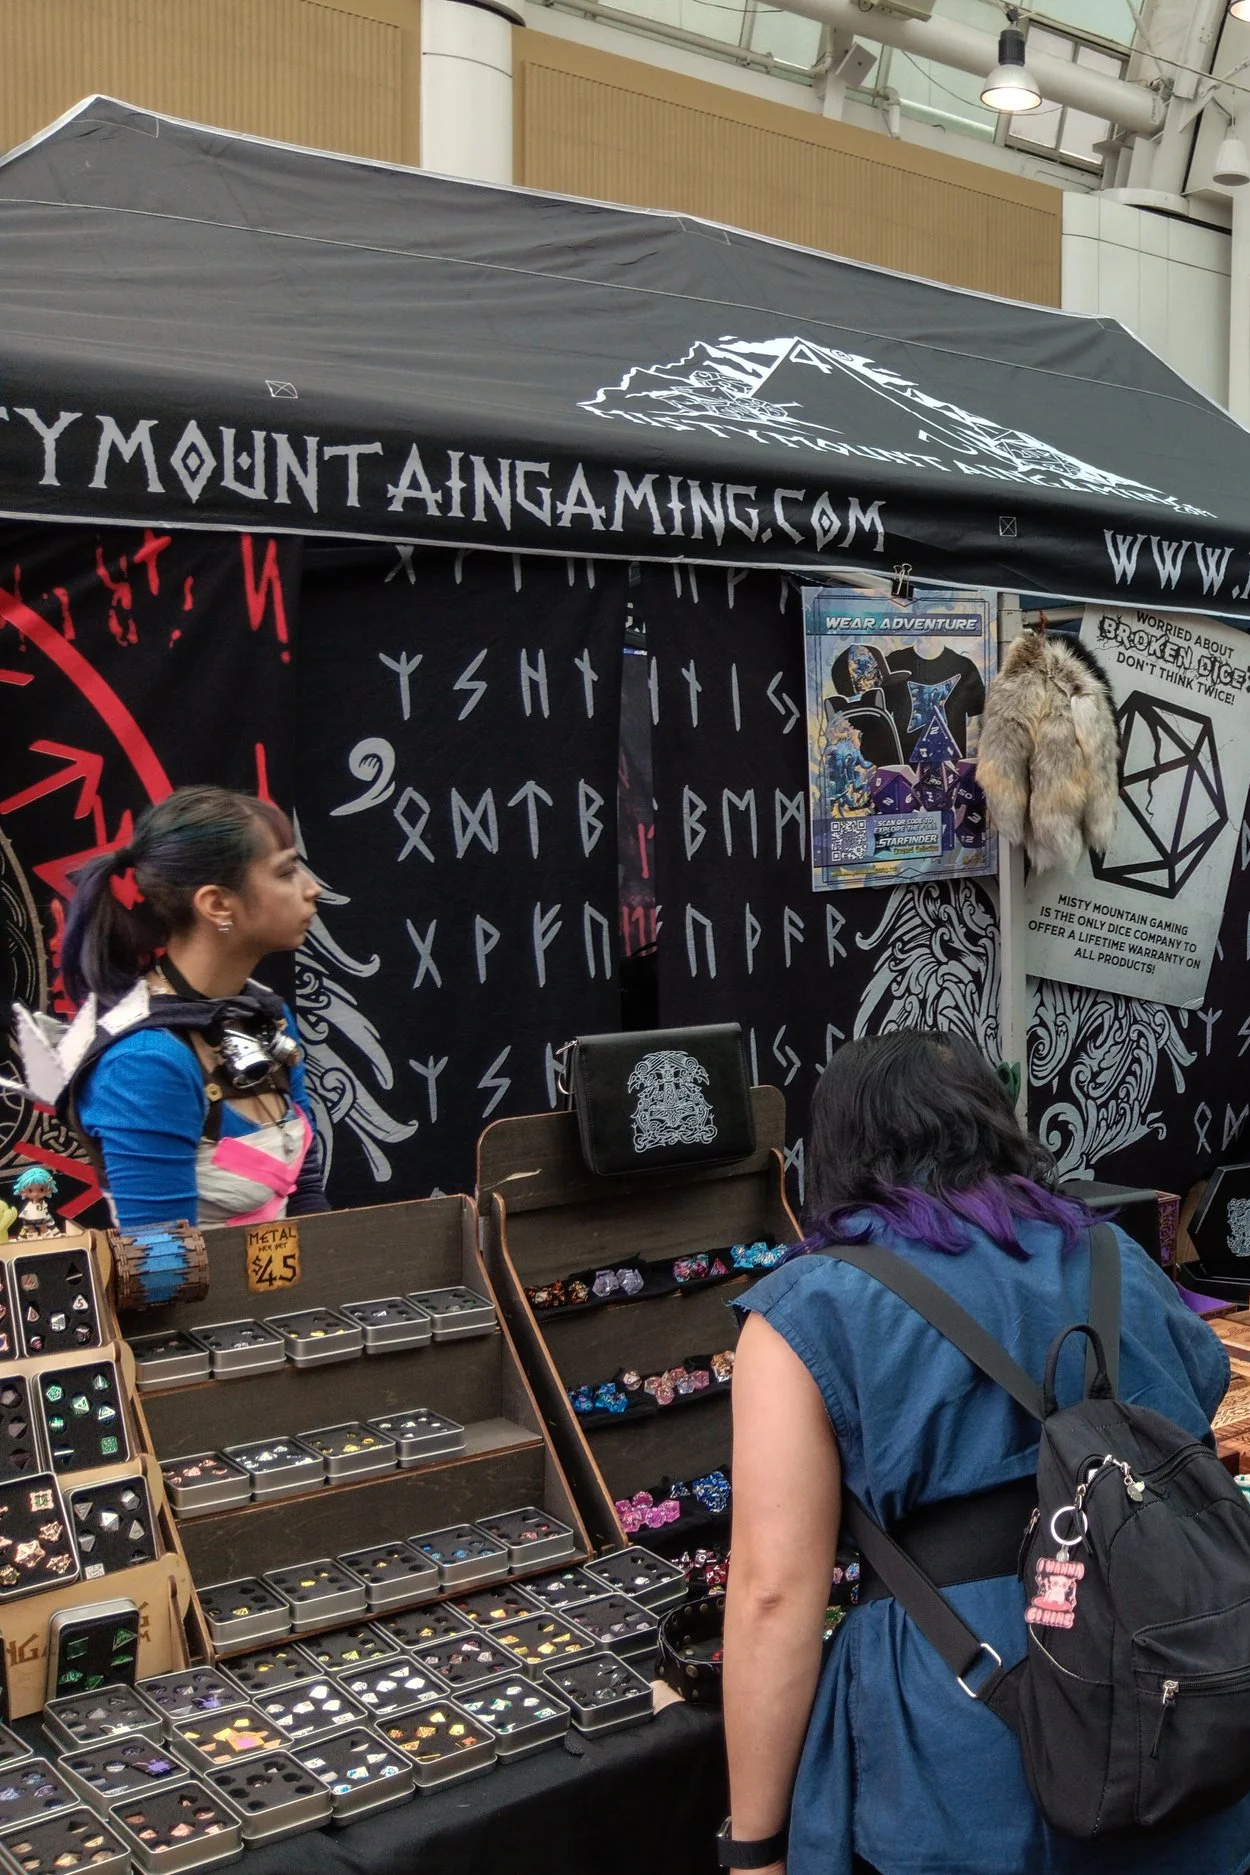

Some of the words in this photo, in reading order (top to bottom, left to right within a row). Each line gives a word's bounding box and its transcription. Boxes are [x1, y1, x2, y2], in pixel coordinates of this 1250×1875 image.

[0, 404, 886, 553] YMOUNTAINGAMING.COM
[826, 617, 876, 631] WEAR
[880, 618, 978, 631] ADVENTURE
[1099, 616, 1194, 670] BROKEN
[1137, 610, 1192, 642] WORRIED
[1194, 635, 1235, 659] ABOUT
[1117, 652, 1156, 675] DON'T
[1159, 667, 1194, 690] THINK
[1197, 681, 1236, 706] TWICE!
[876, 833, 939, 848] STARFINDER
[1040, 906, 1052, 918] IS
[1054, 909, 1075, 924] THE
[1077, 915, 1107, 931] ONLY
[1107, 923, 1132, 937] DICE
[1133, 929, 1182, 951] COMPANY
[1184, 941, 1197, 953] TO
[1058, 894, 1092, 911] MISTY
[1092, 905, 1148, 926] MOUNTAIN
[1150, 918, 1189, 936] GAMING
[1028, 920, 1066, 937] OFFER
[1067, 929, 1076, 940] A
[1078, 932, 1126, 952] LIFETIME
[1128, 943, 1185, 965] WARRANTY
[1186, 958, 1201, 970] ON
[1074, 947, 1096, 961] ALL
[1097, 953, 1156, 975] PRODUCTS!
[249, 1227, 297, 1246] METAL
[251, 1253, 297, 1287] $45
